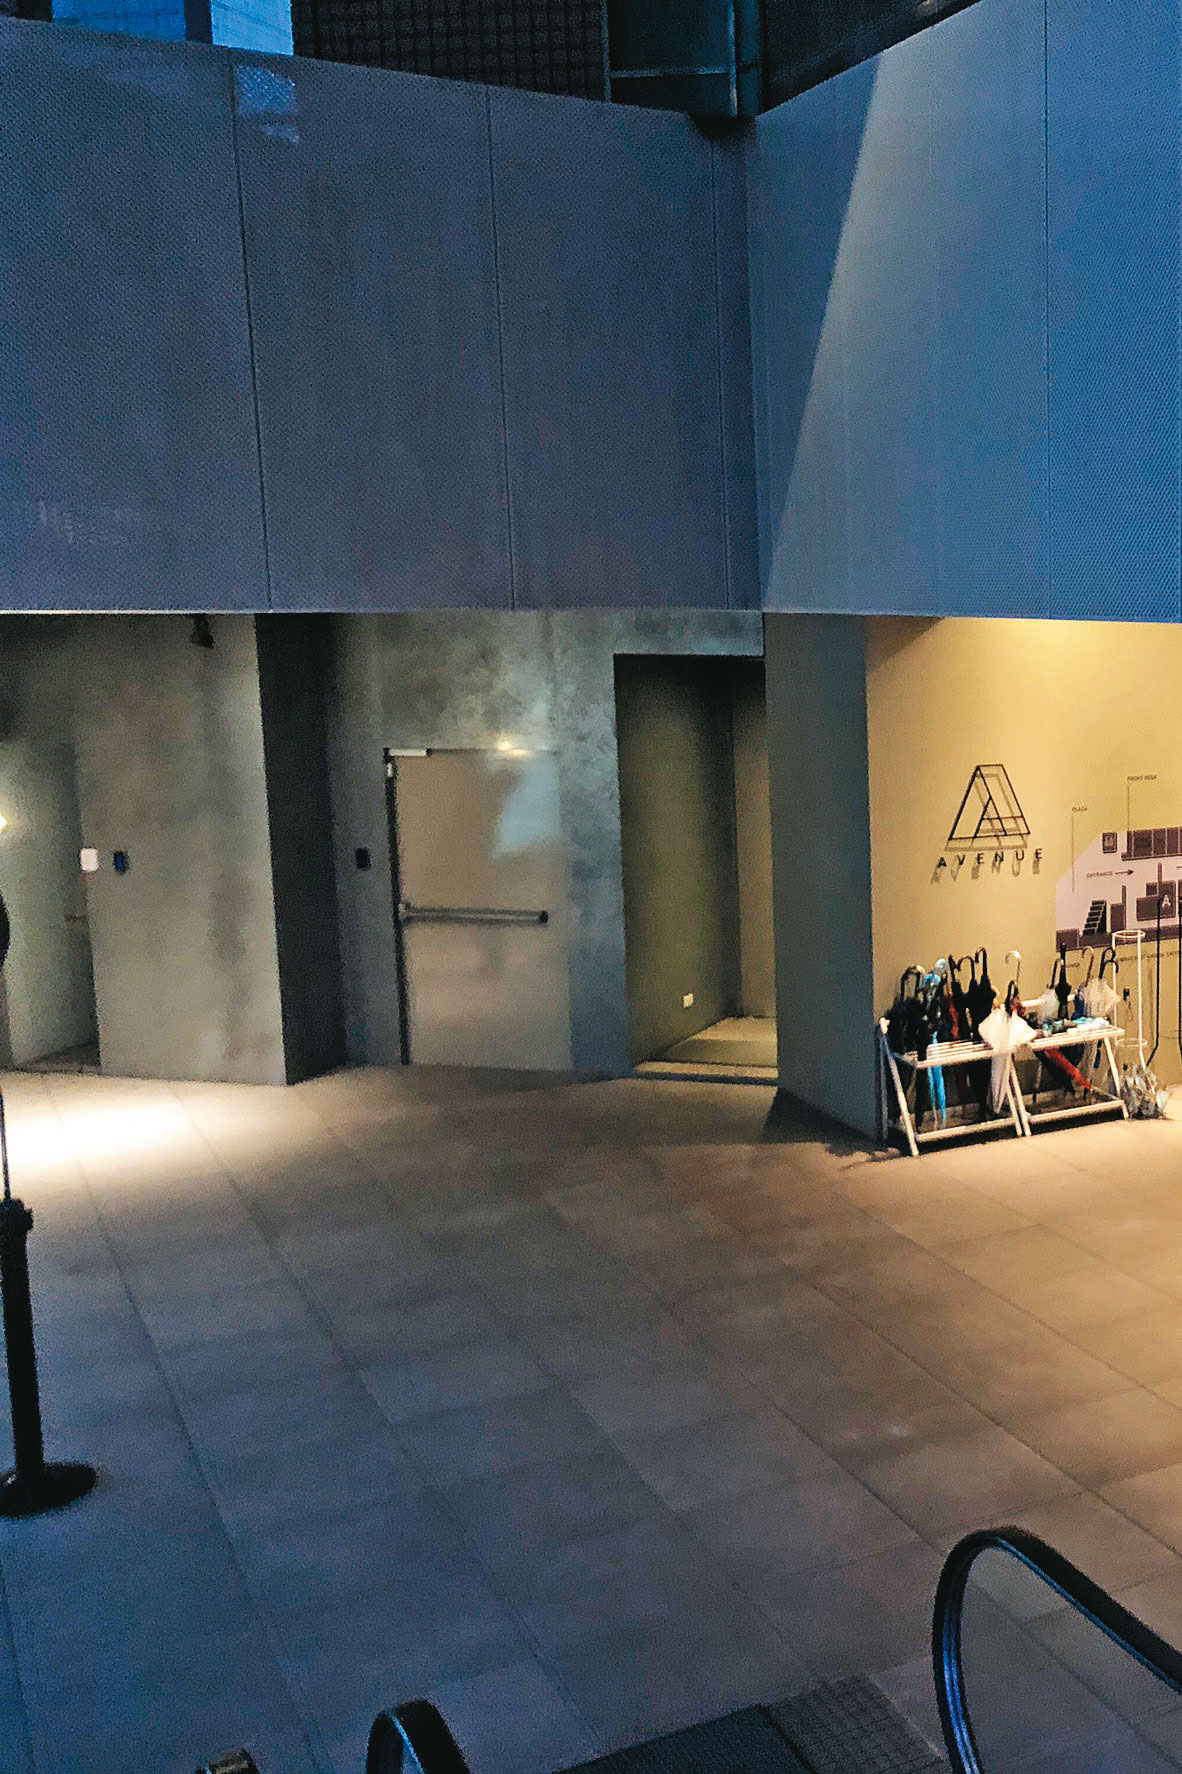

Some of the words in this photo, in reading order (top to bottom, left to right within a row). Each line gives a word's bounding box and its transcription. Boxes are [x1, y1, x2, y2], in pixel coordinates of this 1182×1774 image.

[937, 848, 1043, 868] AVENUE
[1086, 870, 1113, 878] ENTRANCE
[1161, 894, 1171, 908] A
